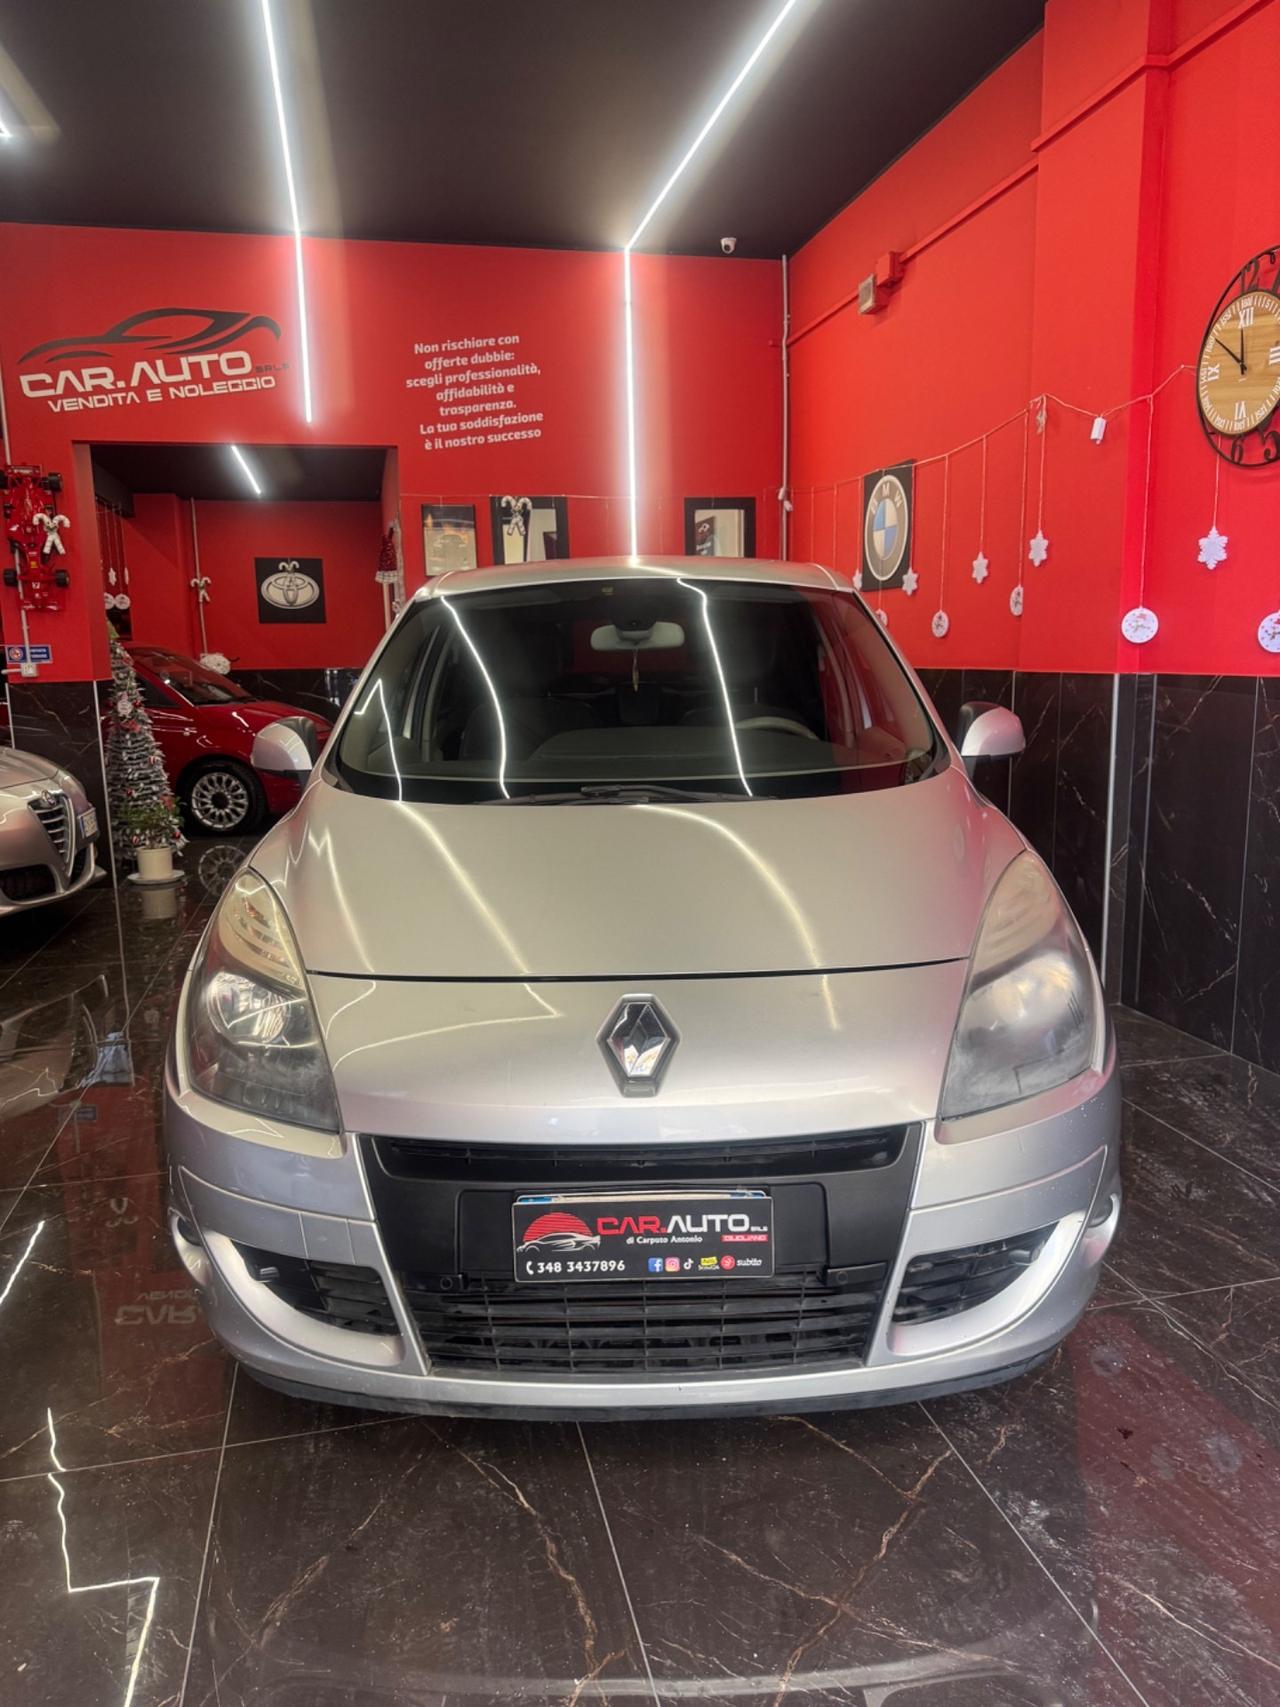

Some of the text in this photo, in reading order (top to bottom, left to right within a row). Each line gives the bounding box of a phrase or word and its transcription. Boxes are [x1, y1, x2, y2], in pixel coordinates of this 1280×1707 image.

[1238, 307, 1254, 329] XII
[414, 334, 520, 354] Non rischiare con
[424, 350, 515, 372] offerte dubbie:
[1207, 363, 1220, 381] IX
[19, 350, 252, 398] CAR.AUTO
[405, 362, 541, 388] scegli professionalità,
[48, 376, 275, 413] VENDITA E NOLEGGIO
[436, 383, 515, 402] affidabilità e
[439, 398, 517, 416] trasparenza.
[420, 411, 544, 435] La tua soddisfazione
[424, 427, 542, 451] è il nostro successo
[596, 1213, 750, 1235] CAR.AUTO
[626, 1234, 703, 1245] di Carputo Antonio
[537, 1260, 626, 1273] 348 3437896
